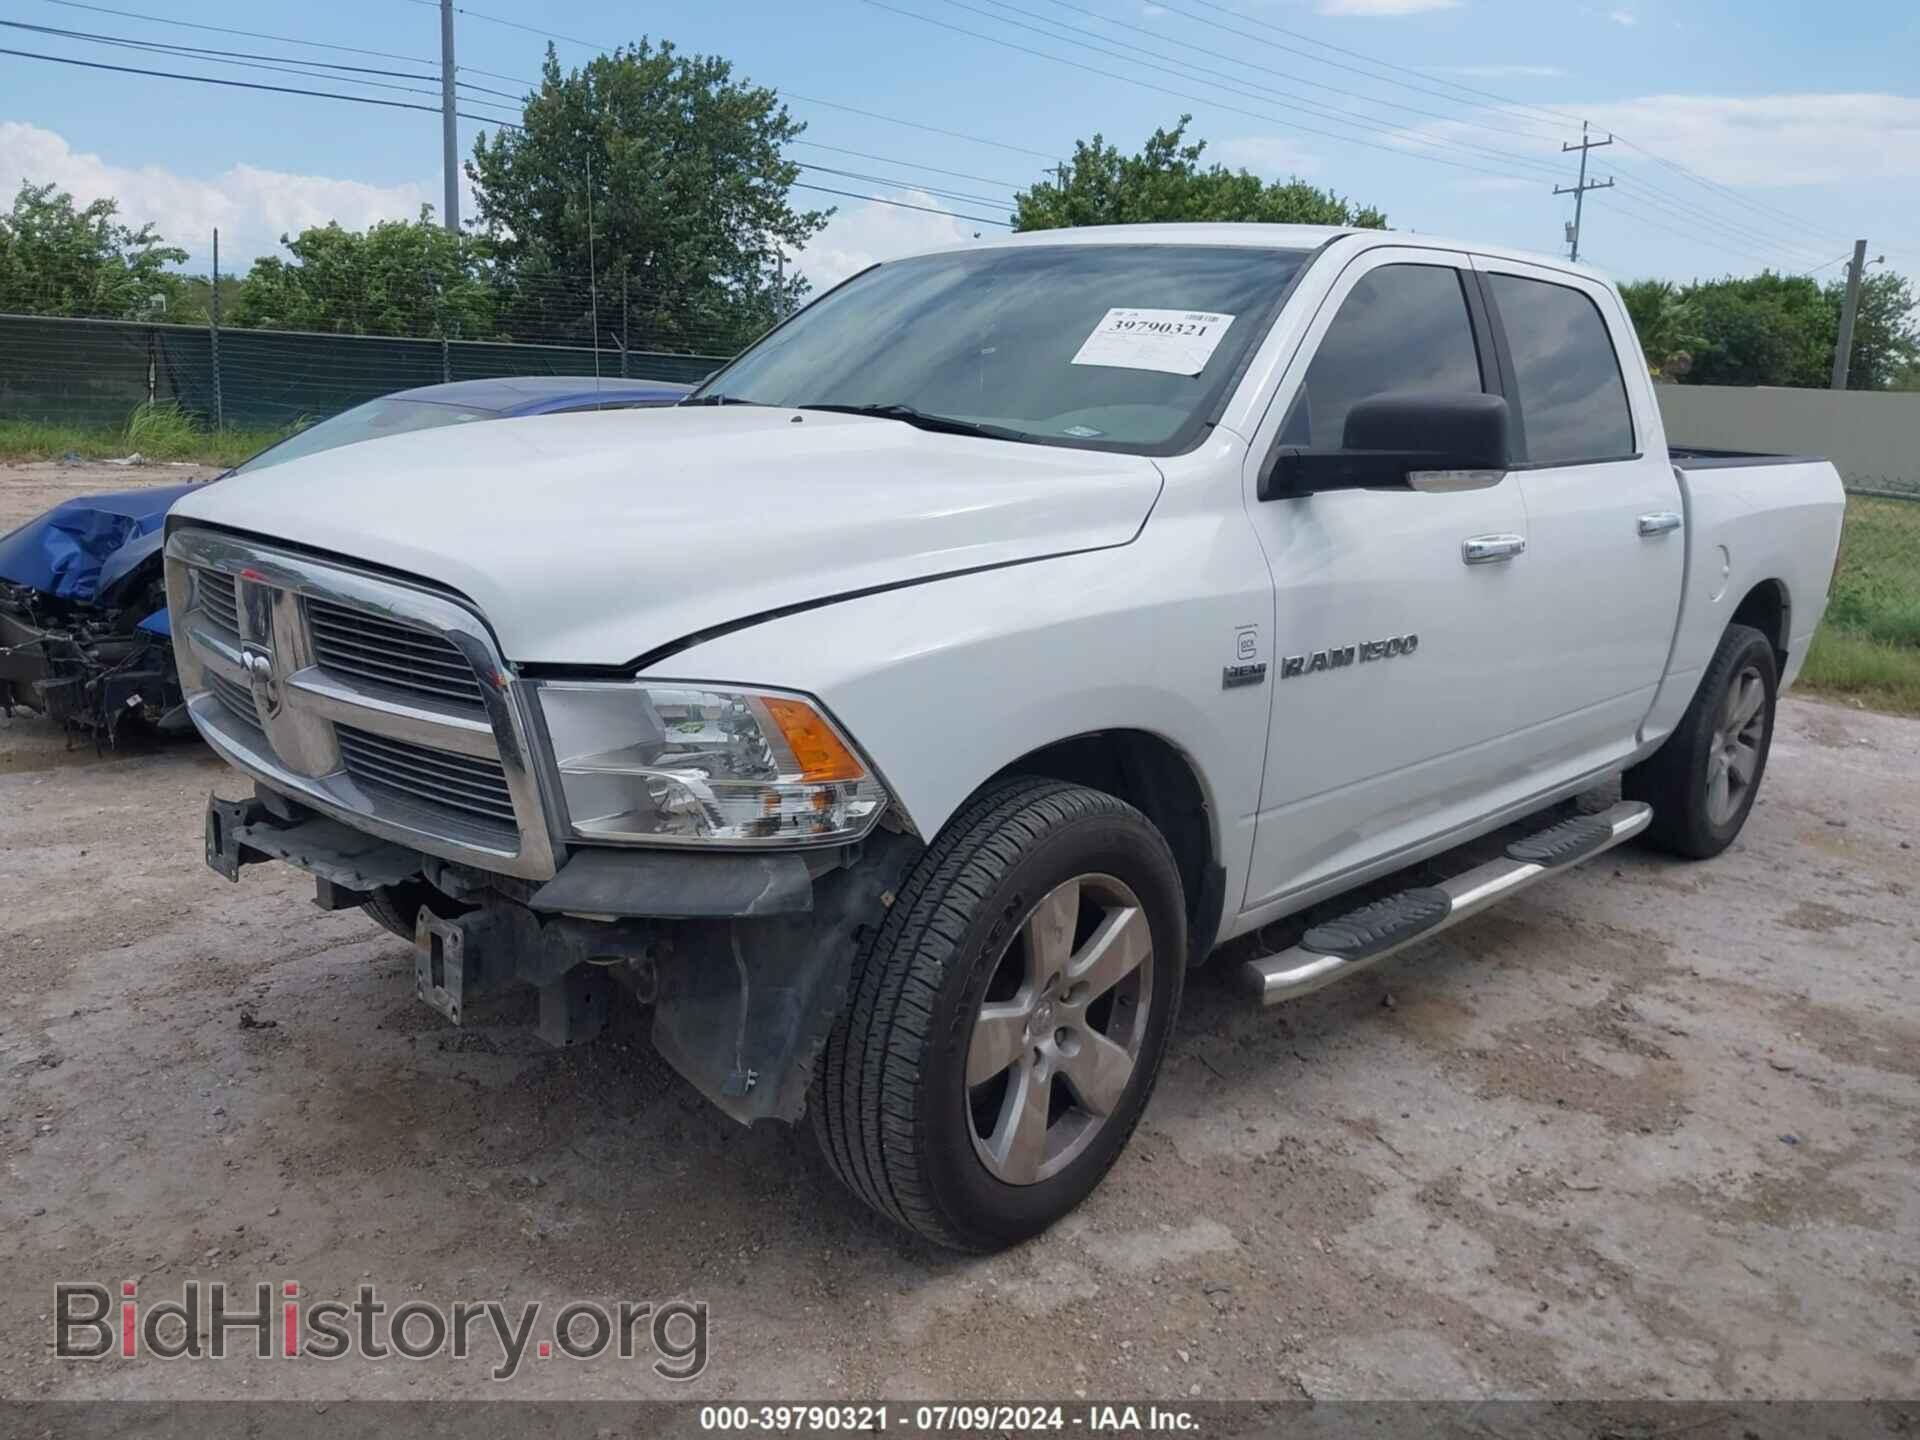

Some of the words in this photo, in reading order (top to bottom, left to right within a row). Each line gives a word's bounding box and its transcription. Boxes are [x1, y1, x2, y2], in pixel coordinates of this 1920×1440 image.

[1108, 320, 1208, 337] 39790321
[1281, 644, 1355, 679] RAM
[1359, 633, 1418, 664] 1500
